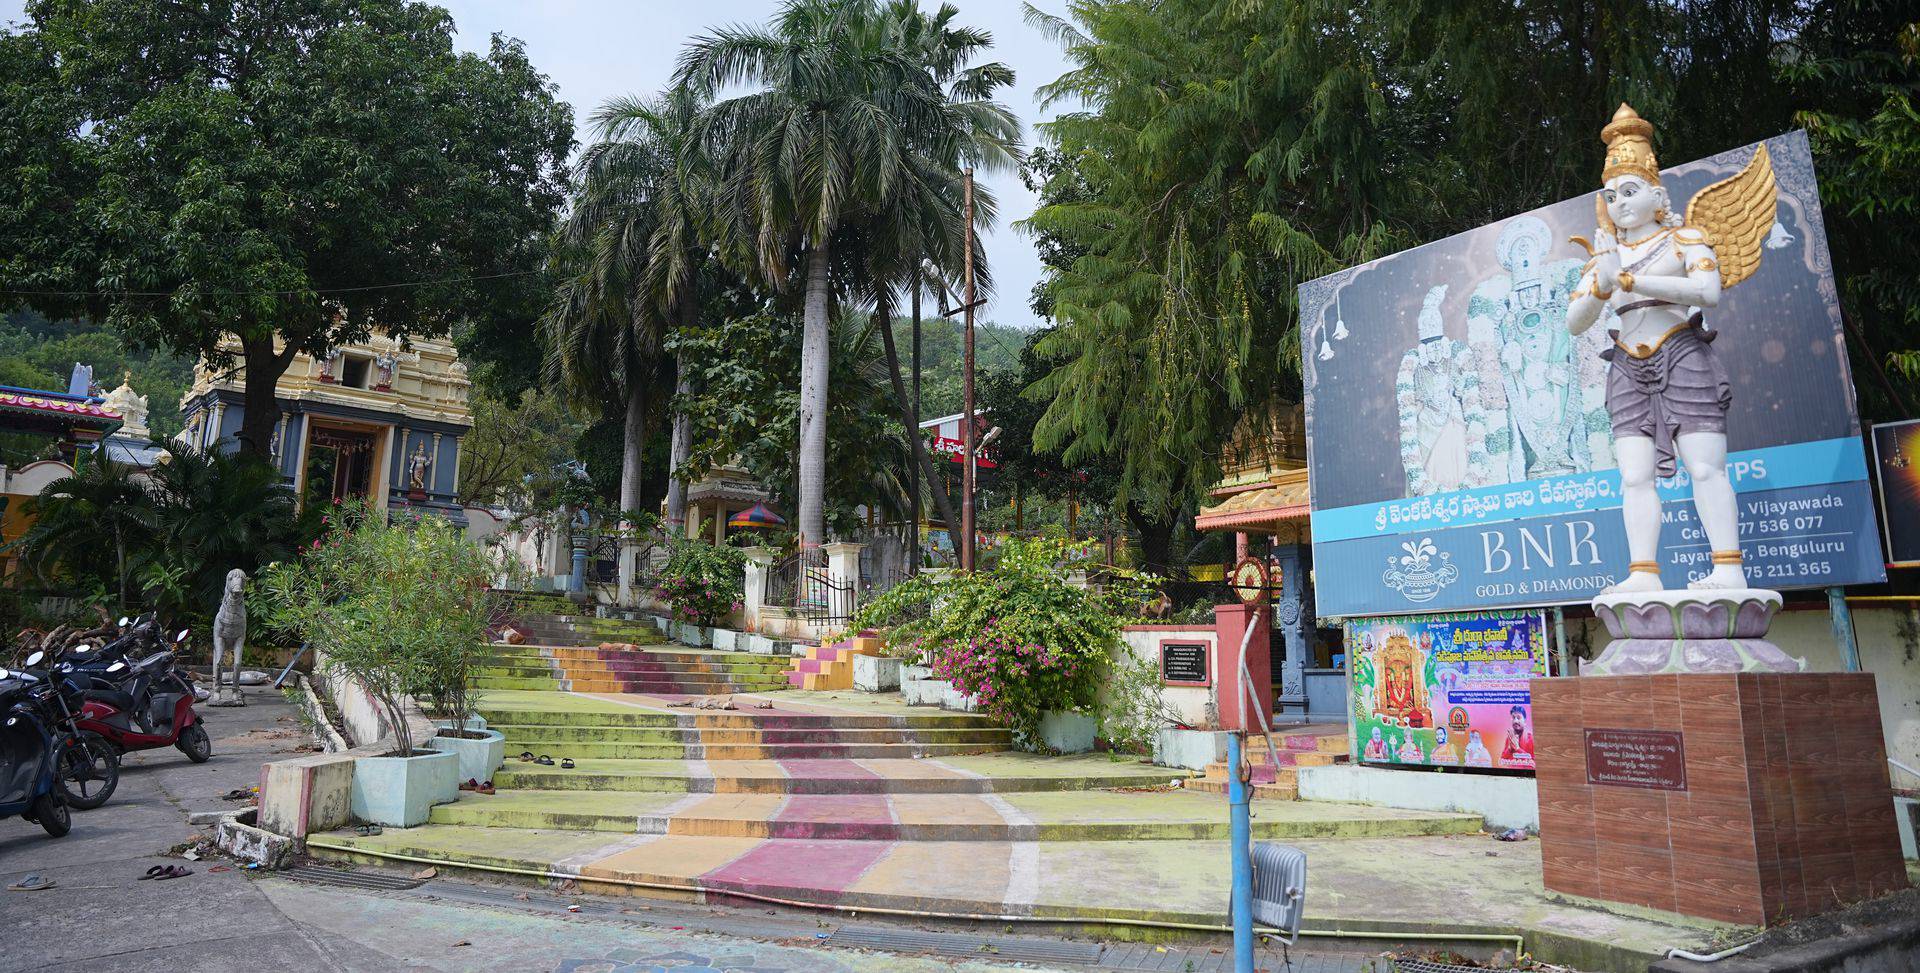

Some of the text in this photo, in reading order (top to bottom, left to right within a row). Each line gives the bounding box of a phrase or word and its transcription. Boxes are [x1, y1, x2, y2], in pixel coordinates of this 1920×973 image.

[1724, 459, 1767, 482] TPS
[1375, 506, 1387, 531] శ్రీ
[1462, 494, 1501, 518] స్వామి
[1748, 494, 1844, 516] Vijayawada
[1681, 527, 1709, 540] Cel
[1760, 519, 1789, 533] 536
[1795, 516, 1824, 530] 077
[1480, 520, 1603, 574] BNR
[1757, 541, 1845, 560] Benguluru
[1687, 569, 1713, 583] Cel
[1768, 564, 1795, 577] 211
[1799, 562, 1831, 576] 365
[1475, 574, 1616, 599] GOLD & DIAMONDS
